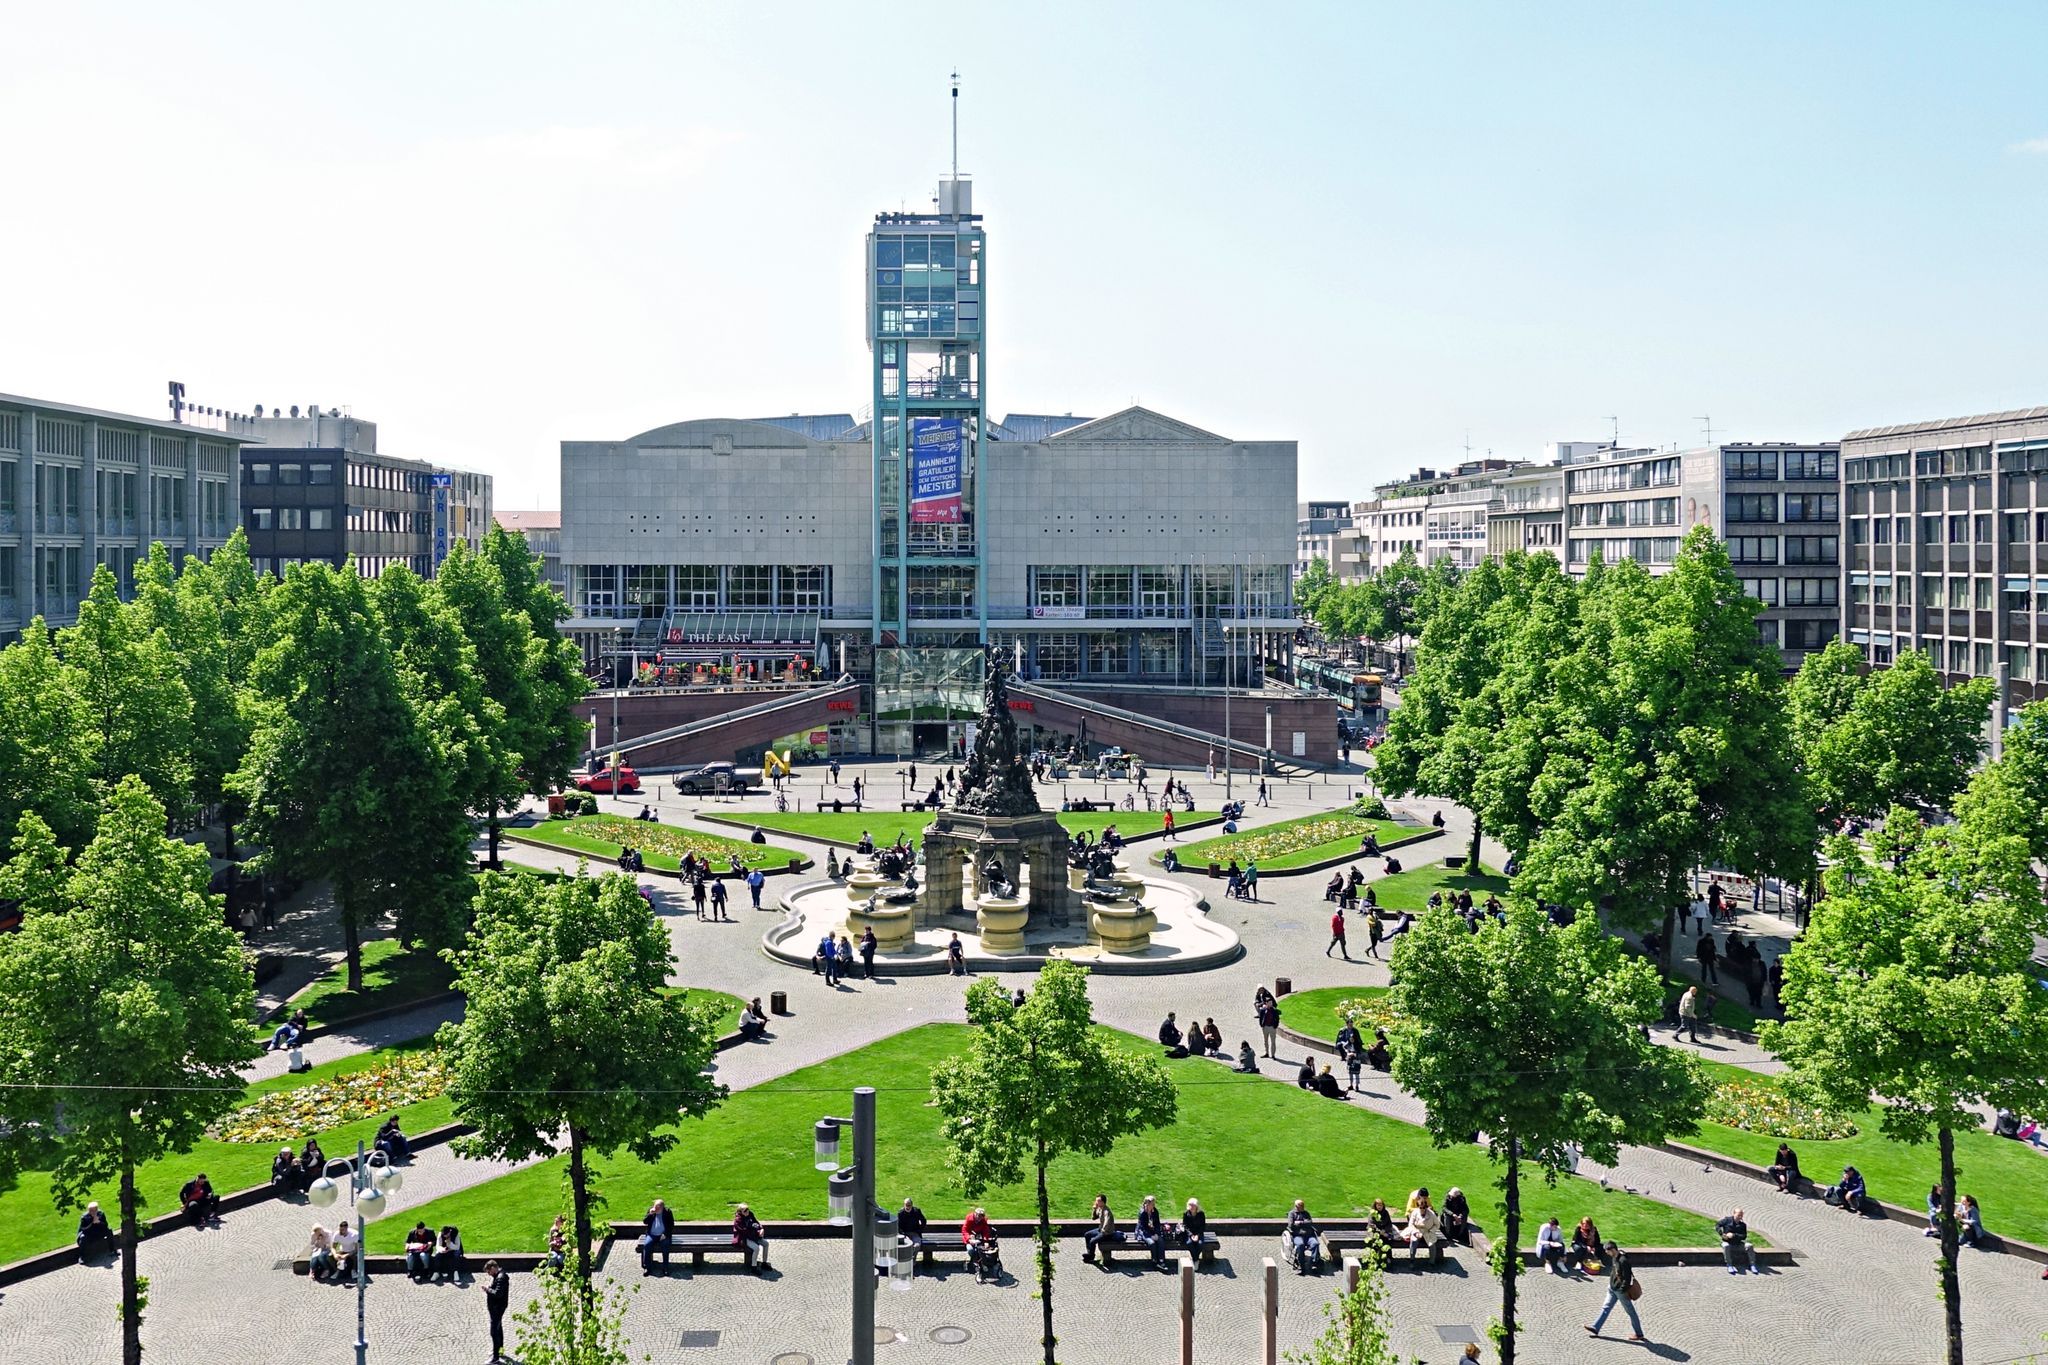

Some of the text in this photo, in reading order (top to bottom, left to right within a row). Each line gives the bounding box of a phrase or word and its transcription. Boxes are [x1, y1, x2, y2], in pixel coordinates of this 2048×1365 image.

[919, 431, 956, 445] MEISTER
[919, 455, 956, 468] MANNHEIM
[919, 464, 956, 477] GRATULIERT
[919, 479, 956, 493] MEISTER
[437, 491, 445, 562] VR BAN
[688, 633, 749, 643] THE EAST
[827, 701, 854, 711] REWE
